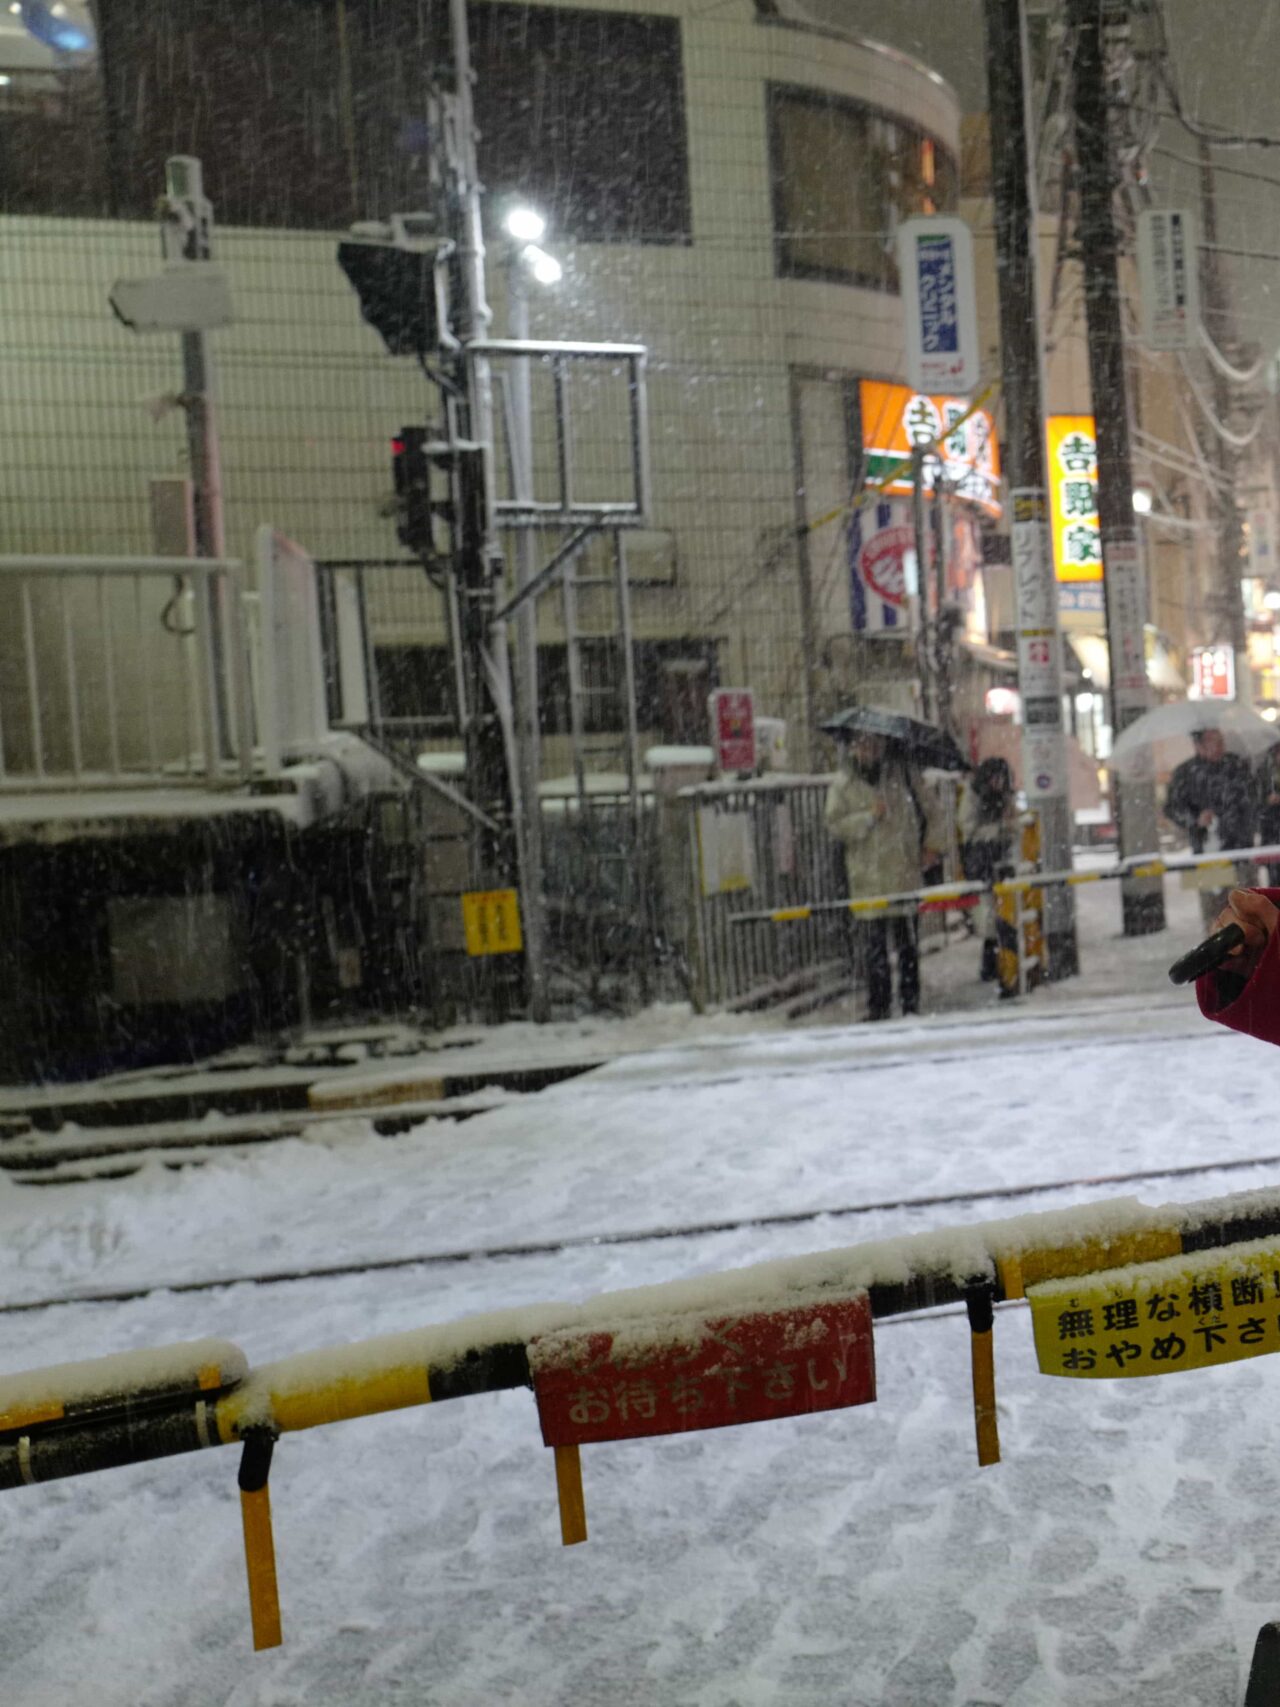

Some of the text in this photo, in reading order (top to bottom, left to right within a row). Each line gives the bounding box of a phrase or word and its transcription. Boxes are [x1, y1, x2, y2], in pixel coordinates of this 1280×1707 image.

[1060, 434, 1102, 562] 吉野家
[568, 1356, 848, 1424] お待ち下さい
